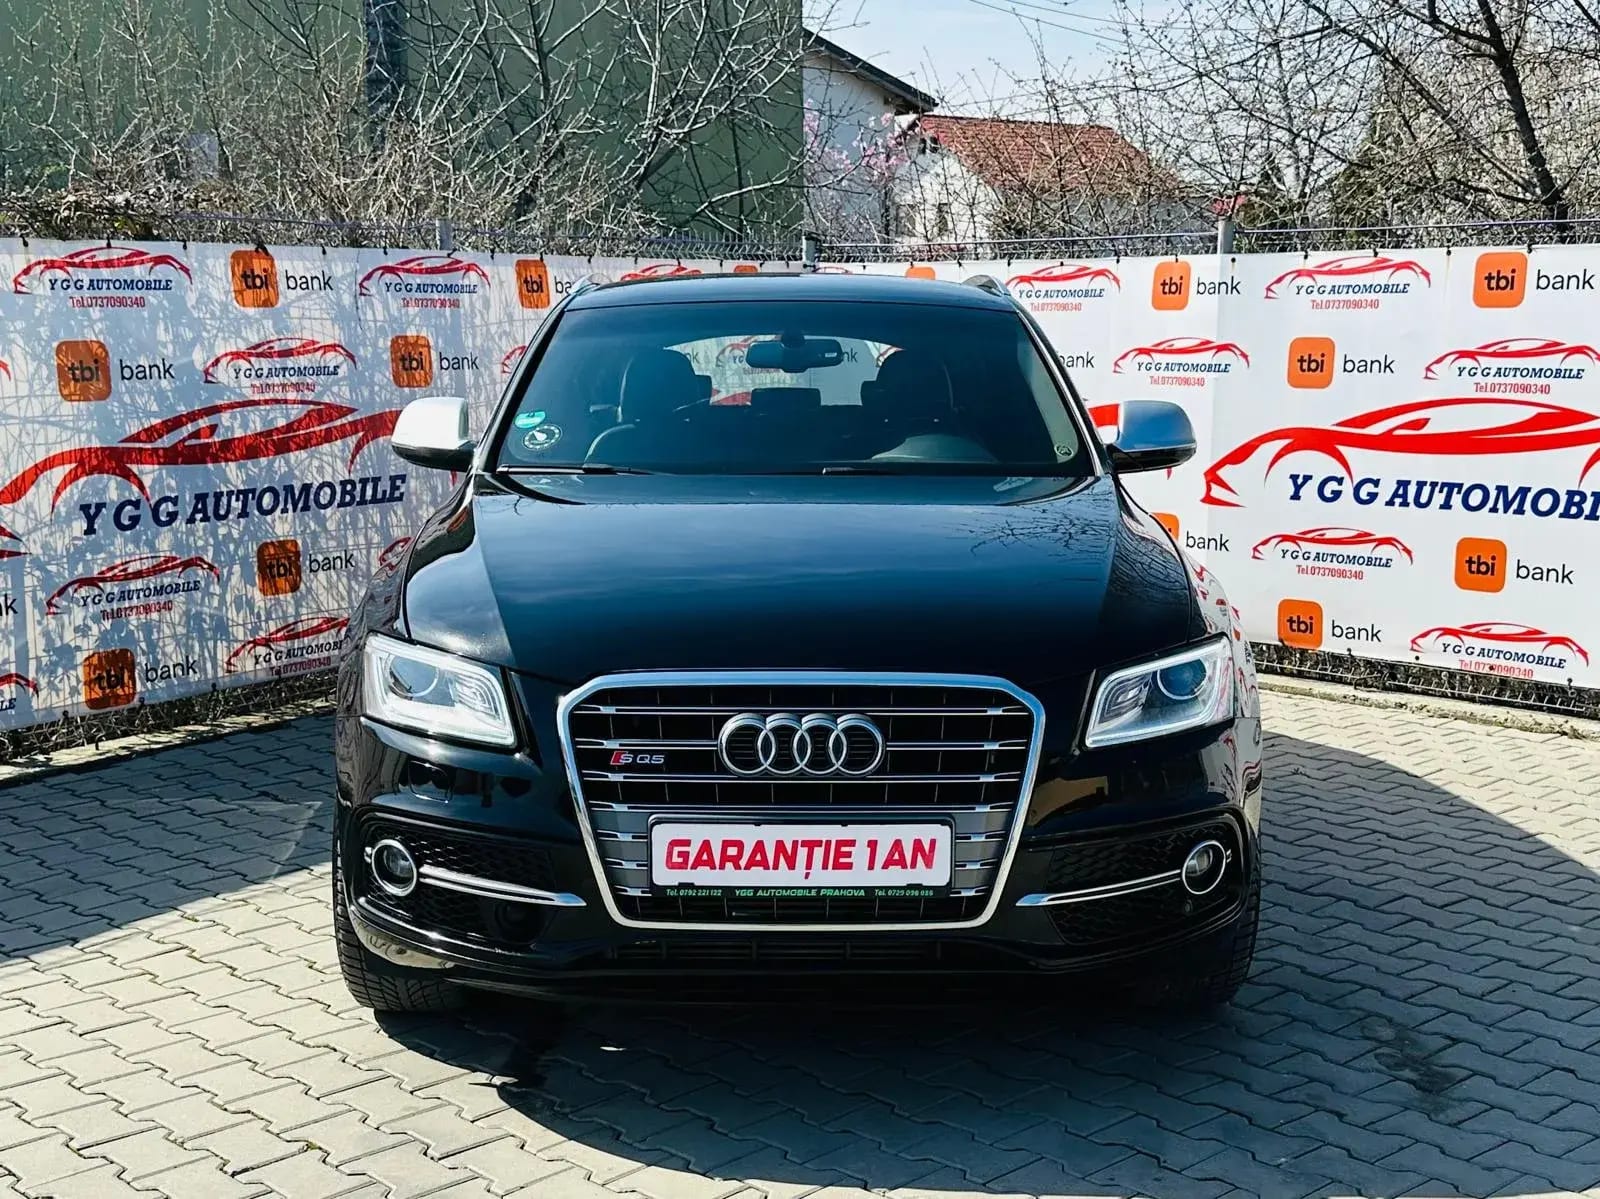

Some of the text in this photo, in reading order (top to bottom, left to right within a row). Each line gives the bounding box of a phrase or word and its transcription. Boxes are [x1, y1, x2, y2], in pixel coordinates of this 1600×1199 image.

[87, 279, 173, 291] AUTOMOBILE
[241, 268, 334, 291] tbi bank
[415, 283, 478, 294] AUTOMOBILE
[523, 274, 544, 293] tbi
[1160, 274, 1241, 296] tbi bank
[1328, 283, 1410, 295] AUTOMOBILE
[1484, 268, 1595, 291] tbi bank
[1042, 288, 1105, 299] AUTOMOBILE
[68, 358, 175, 382] tbi bank
[266, 365, 340, 378] AUTOMOBILE
[400, 351, 480, 371] tbi bank
[1163, 362, 1231, 374] AUTOMOBILE
[1297, 353, 1396, 374] tbi bank
[1493, 367, 1585, 380] AUTOMOBILE
[185, 473, 407, 524] AUTOMOBILE
[1186, 531, 1230, 552] bank
[309, 550, 355, 573] bank
[1312, 551, 1393, 568] AUTOMOBILE
[1465, 554, 1574, 585] tbi bank
[118, 580, 201, 602] AUTOMOBILE
[1286, 615, 1382, 642] tbi bank
[1476, 647, 1567, 669] AUTOMOBILE
[144, 655, 198, 683] bank
[665, 838, 937, 880] GARANȚIE 1 AN
[735, 889, 866, 897] YGG AUTOMOBILE PRAHOVA
